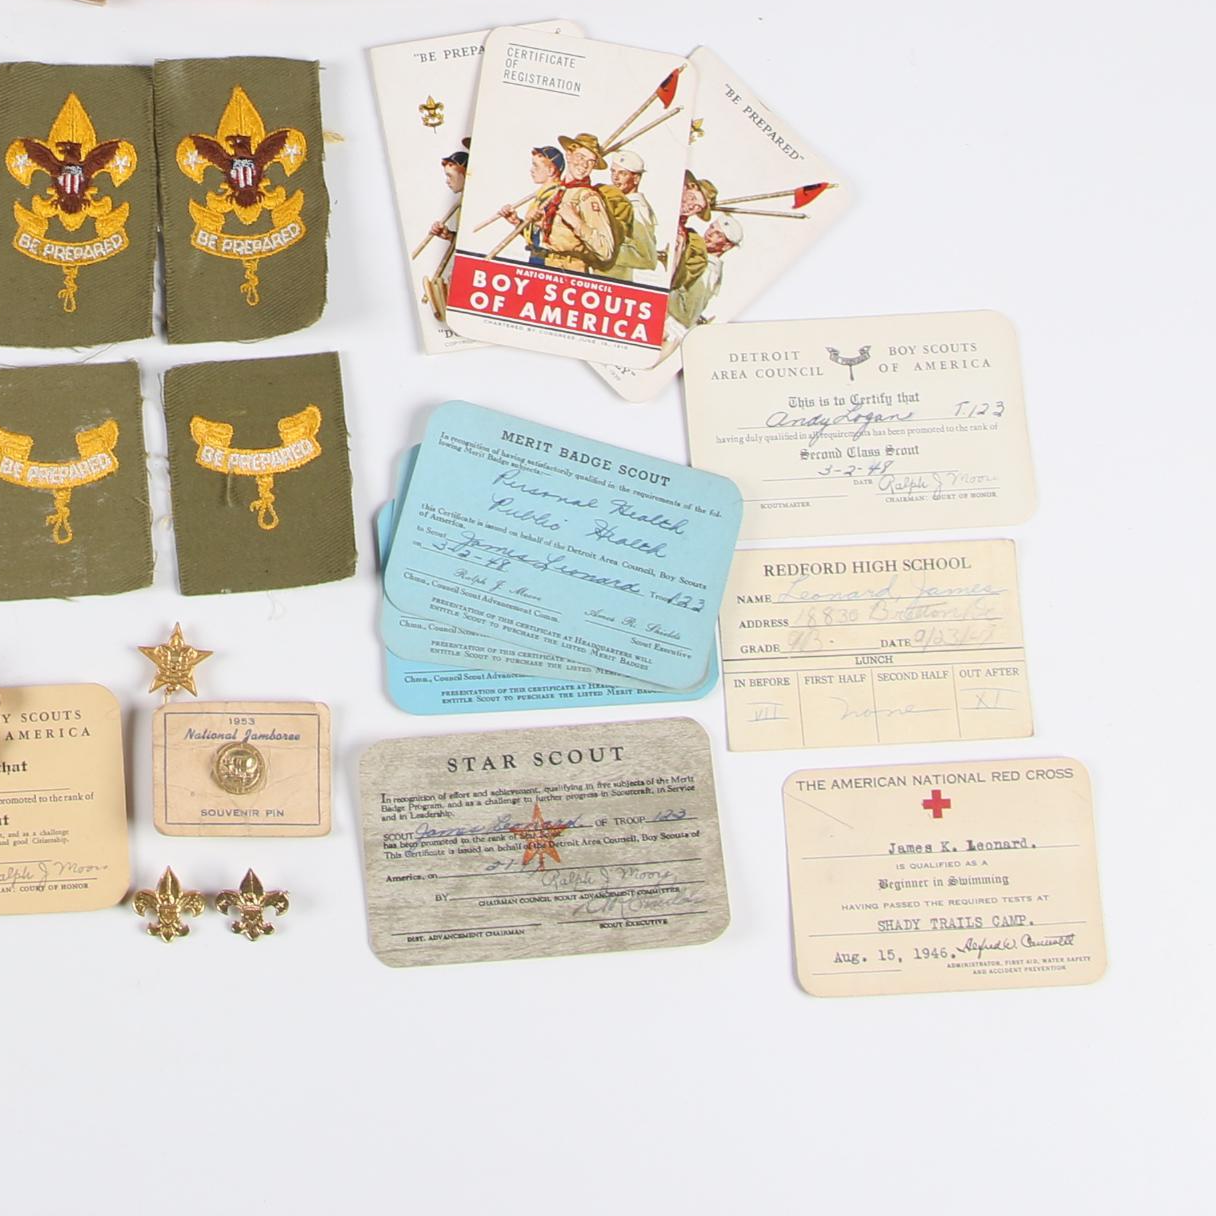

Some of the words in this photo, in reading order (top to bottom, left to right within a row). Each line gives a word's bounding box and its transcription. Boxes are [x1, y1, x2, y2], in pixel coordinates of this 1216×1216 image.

[505, 59, 519, 69] OF
[506, 47, 576, 69] CERTIFICATE
[503, 68, 582, 92] REGISTRATION
[18, 234, 38, 252] BE
[43, 234, 123, 259] PREPARED
[197, 232, 218, 250] BE
[222, 224, 301, 255] PREPARED
[515, 268, 565, 284] NATIONAL
[570, 278, 613, 294] COUNCIL
[472, 269, 530, 296] BOY
[543, 284, 652, 320] SCOUTS
[469, 291, 506, 313] OF
[519, 302, 649, 342] AMERICA
[729, 350, 800, 363] DETROIT
[888, 345, 918, 356] BOY
[923, 342, 977, 354] SCOUTS
[711, 369, 748, 381] AREA
[755, 366, 824, 379] COUNCIL
[878, 362, 900, 373] OF
[914, 359, 991, 371] AMERICA
[788, 396, 815, 410] This
[819, 396, 829, 407] is
[833, 394, 845, 406] to
[850, 391, 893, 407] Certify
[896, 391, 920, 404] that
[200, 446, 224, 464] BE
[227, 441, 312, 470] PREPARED
[501, 430, 553, 454] MERIT
[560, 447, 612, 471] BADGE
[618, 464, 671, 487] SCOUT
[800, 446, 842, 460] Second
[846, 444, 880, 458] Class
[885, 443, 919, 456] Scout
[0, 457, 23, 478] BE
[26, 454, 113, 486] PREPARED
[763, 562, 846, 577] REDFORD
[852, 560, 897, 573] HIGH
[903, 557, 972, 571] SCHOOL
[737, 593, 772, 604] NAME
[739, 618, 789, 629] ADDRESS
[740, 643, 781, 653] GRADE
[880, 638, 911, 648] DATE
[855, 656, 893, 665] LUNCH
[804, 675, 833, 685] FIRST
[839, 674, 867, 683] HALF
[877, 672, 919, 682] SECOND
[922, 670, 949, 680] HALF
[959, 668, 982, 678] OUT
[985, 667, 1019, 677] AFTER
[734, 679, 746, 687] IN
[749, 677, 790, 686] BEFORE
[21, 709, 82, 723] SCOUTS
[228, 717, 256, 725] 1953
[5, 726, 90, 741] AMERICA
[184, 728, 237, 741] National
[243, 728, 301, 743] Jamboree
[446, 754, 517, 773] STAR
[533, 746, 625, 767] SCOUT
[796, 780, 826, 791] THE
[831, 776, 907, 789] AMERICAN
[912, 772, 986, 785] NATIONAL
[991, 770, 1020, 782] RED
[1025, 768, 1074, 780] CROSS
[200, 809, 259, 818] SOUVENIR
[266, 808, 285, 817] PIN
[888, 841, 932, 855] James
[940, 841, 958, 852] K.
[965, 838, 1037, 851] Leonard.
[878, 878, 929, 891] Beginner
[933, 877, 943, 887] in
[947, 874, 1010, 887] Swimming
[841, 903, 879, 911] HAVING
[883, 901, 920, 909] PASSED
[948, 897, 997, 906] REQUIRED
[1002, 895, 1032, 903] TESTS
[877, 919, 920, 932] SHADY
[930, 917, 982, 930] TRAILS
[992, 915, 1034, 927] CAMP.
[833, 952, 868, 965] Aug.
[878, 949, 903, 963] 15,
[913, 947, 956, 960] 1946.
